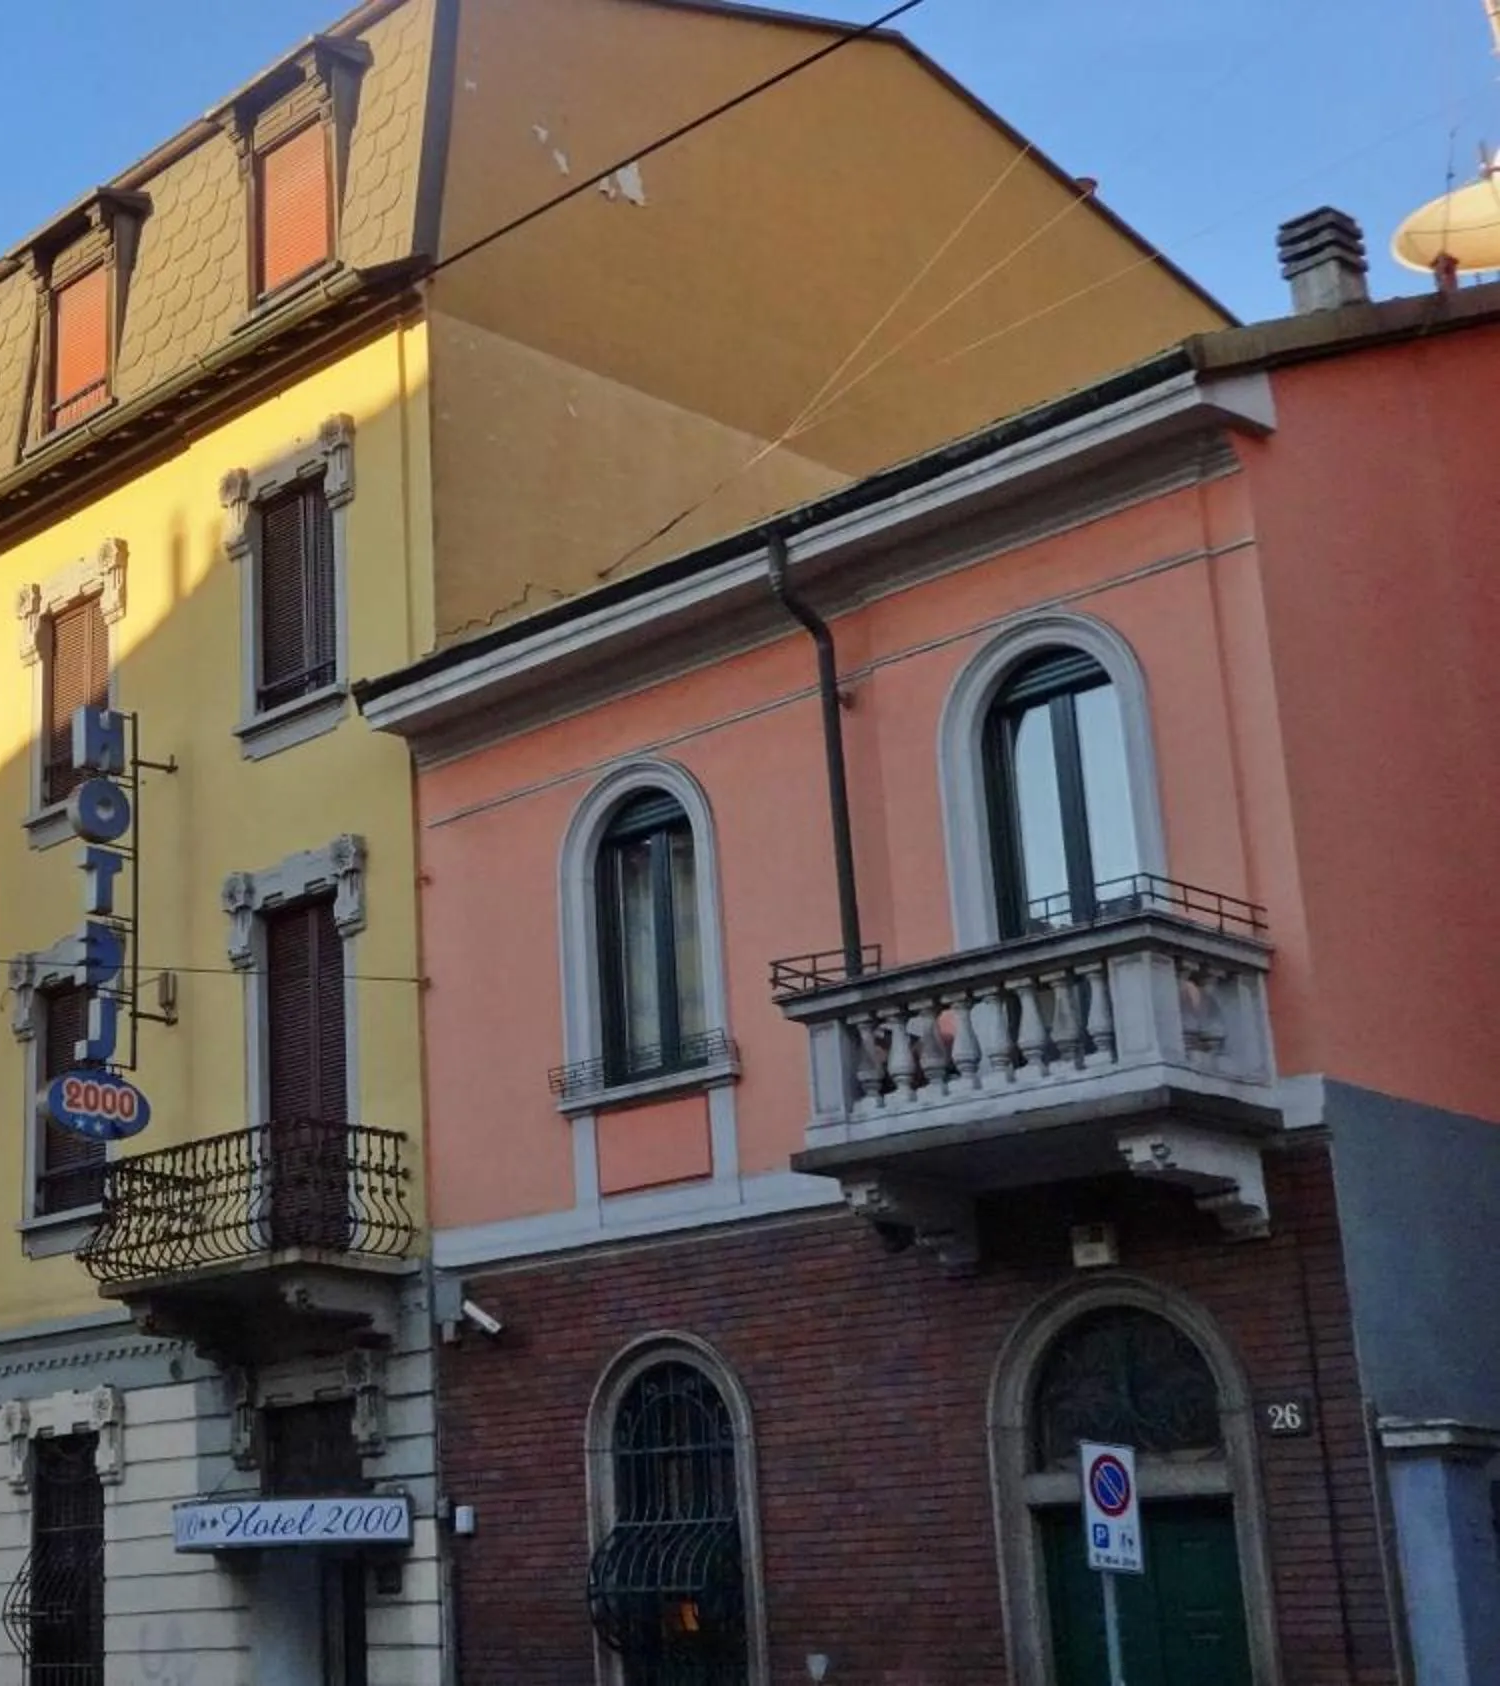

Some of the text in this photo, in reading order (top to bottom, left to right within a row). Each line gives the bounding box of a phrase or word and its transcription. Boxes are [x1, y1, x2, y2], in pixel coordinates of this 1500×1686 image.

[64, 1078, 137, 1121] 2000
[1267, 1402, 1301, 1430] 26
[222, 1503, 316, 1538] Hotel
[320, 1505, 404, 1535] 2000
